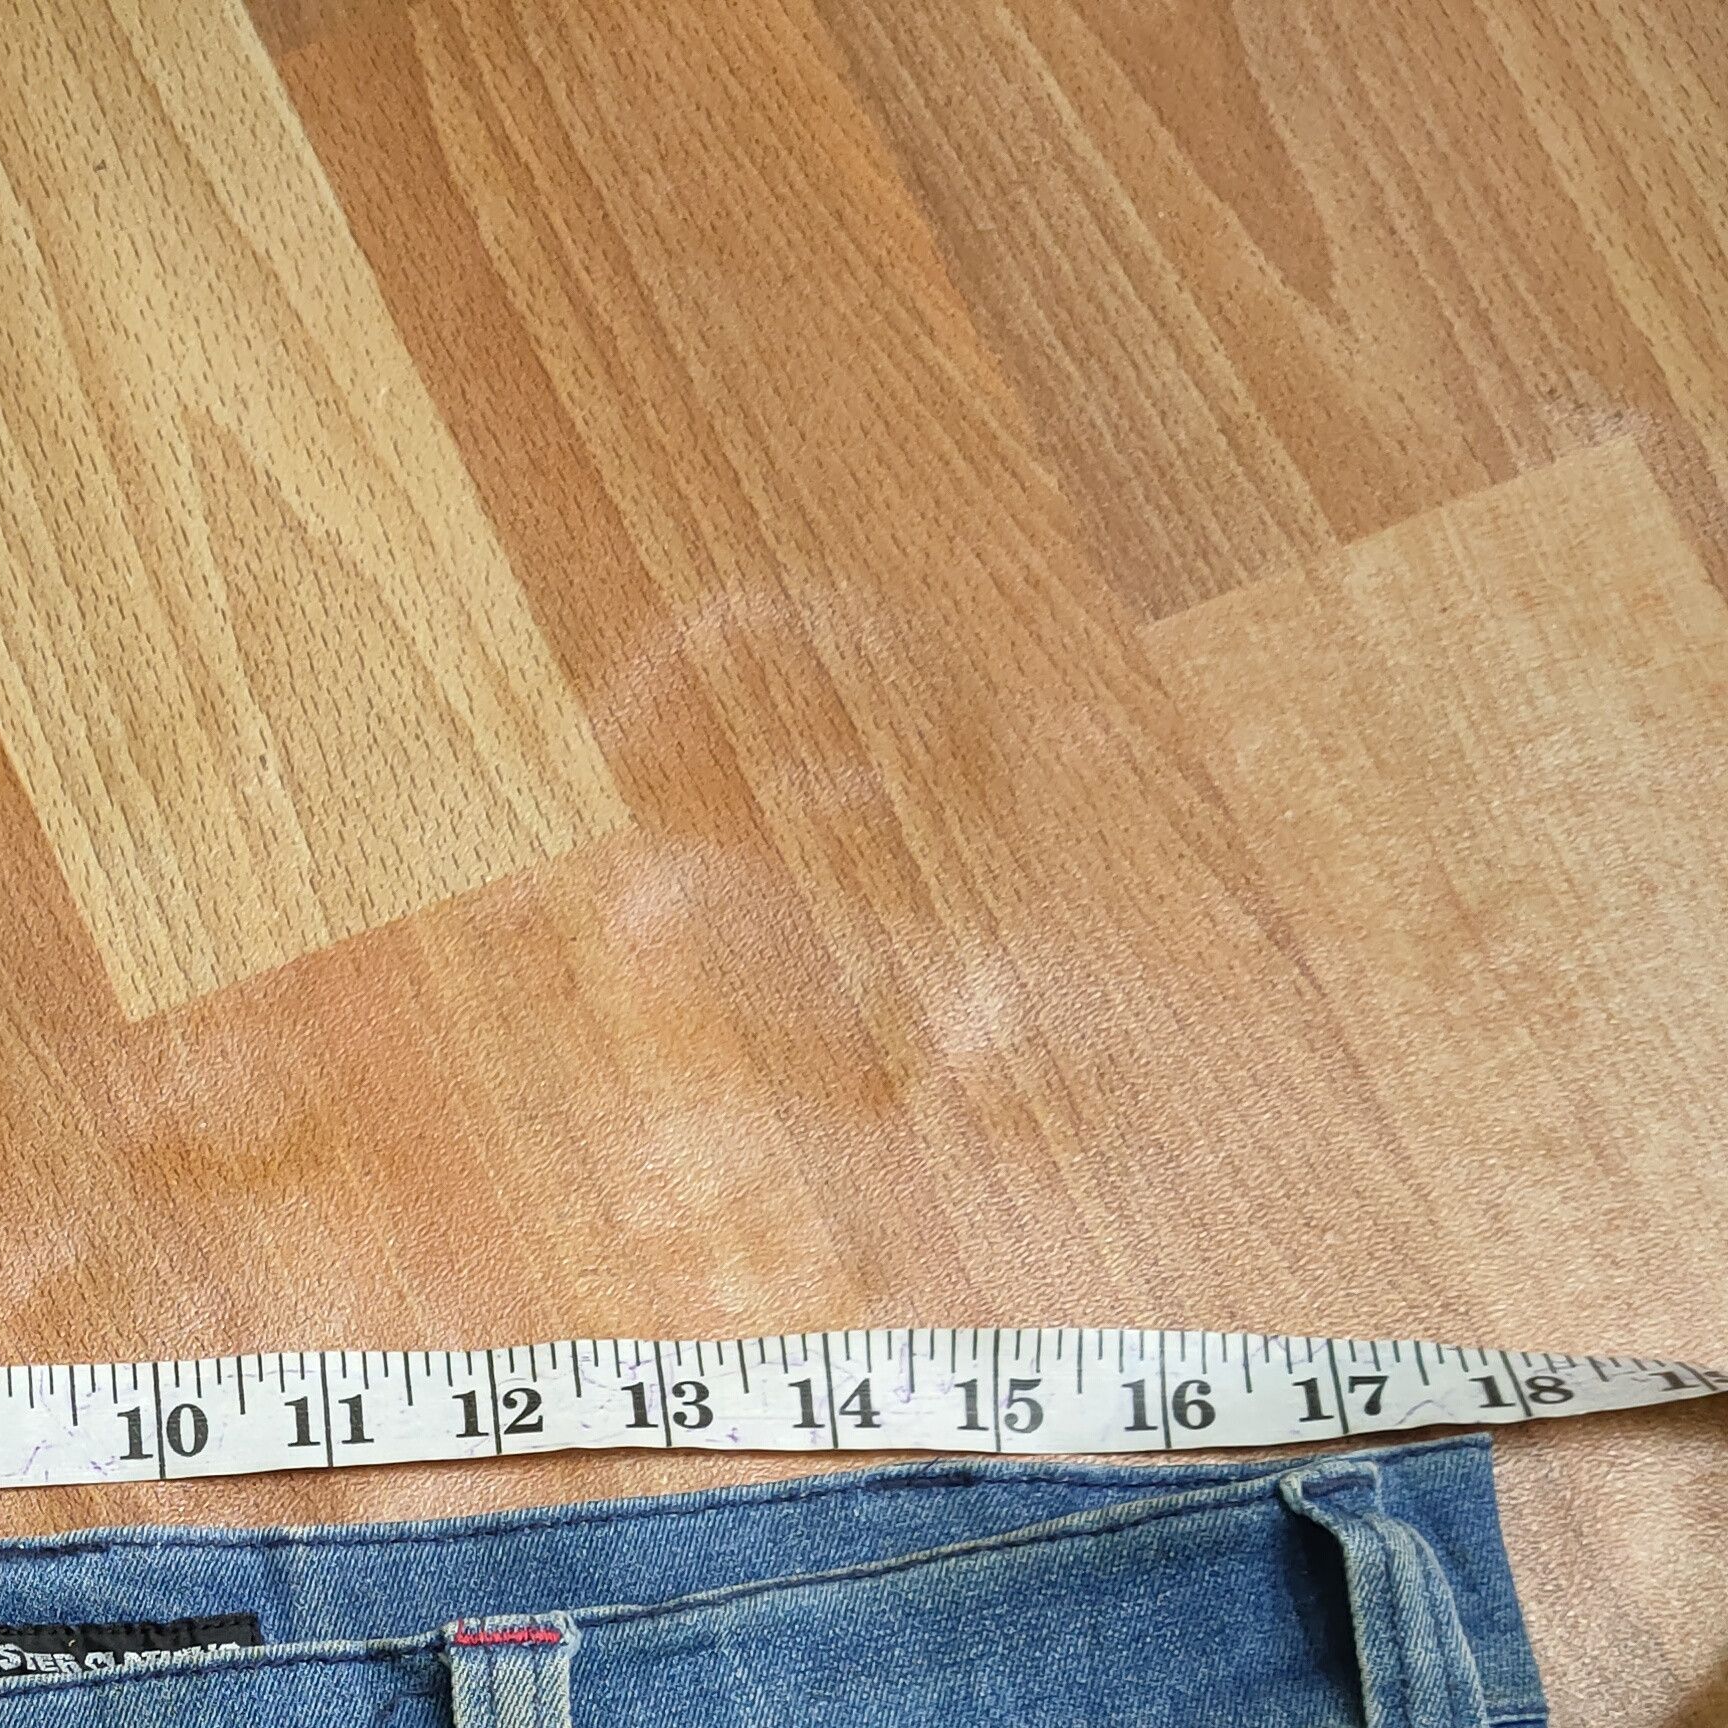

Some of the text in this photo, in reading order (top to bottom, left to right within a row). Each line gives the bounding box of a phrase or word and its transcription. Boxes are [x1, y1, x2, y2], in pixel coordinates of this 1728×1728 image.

[453, 1387, 544, 1439] 12
[621, 1380, 713, 1429] 13
[788, 1378, 881, 1429] 14
[954, 1378, 1044, 1433] 15
[1122, 1379, 1216, 1431] 16
[1293, 1375, 1389, 1422] 17
[1469, 1375, 1574, 1409] 18
[117, 1403, 209, 1461] 10
[286, 1394, 375, 1448] 11
